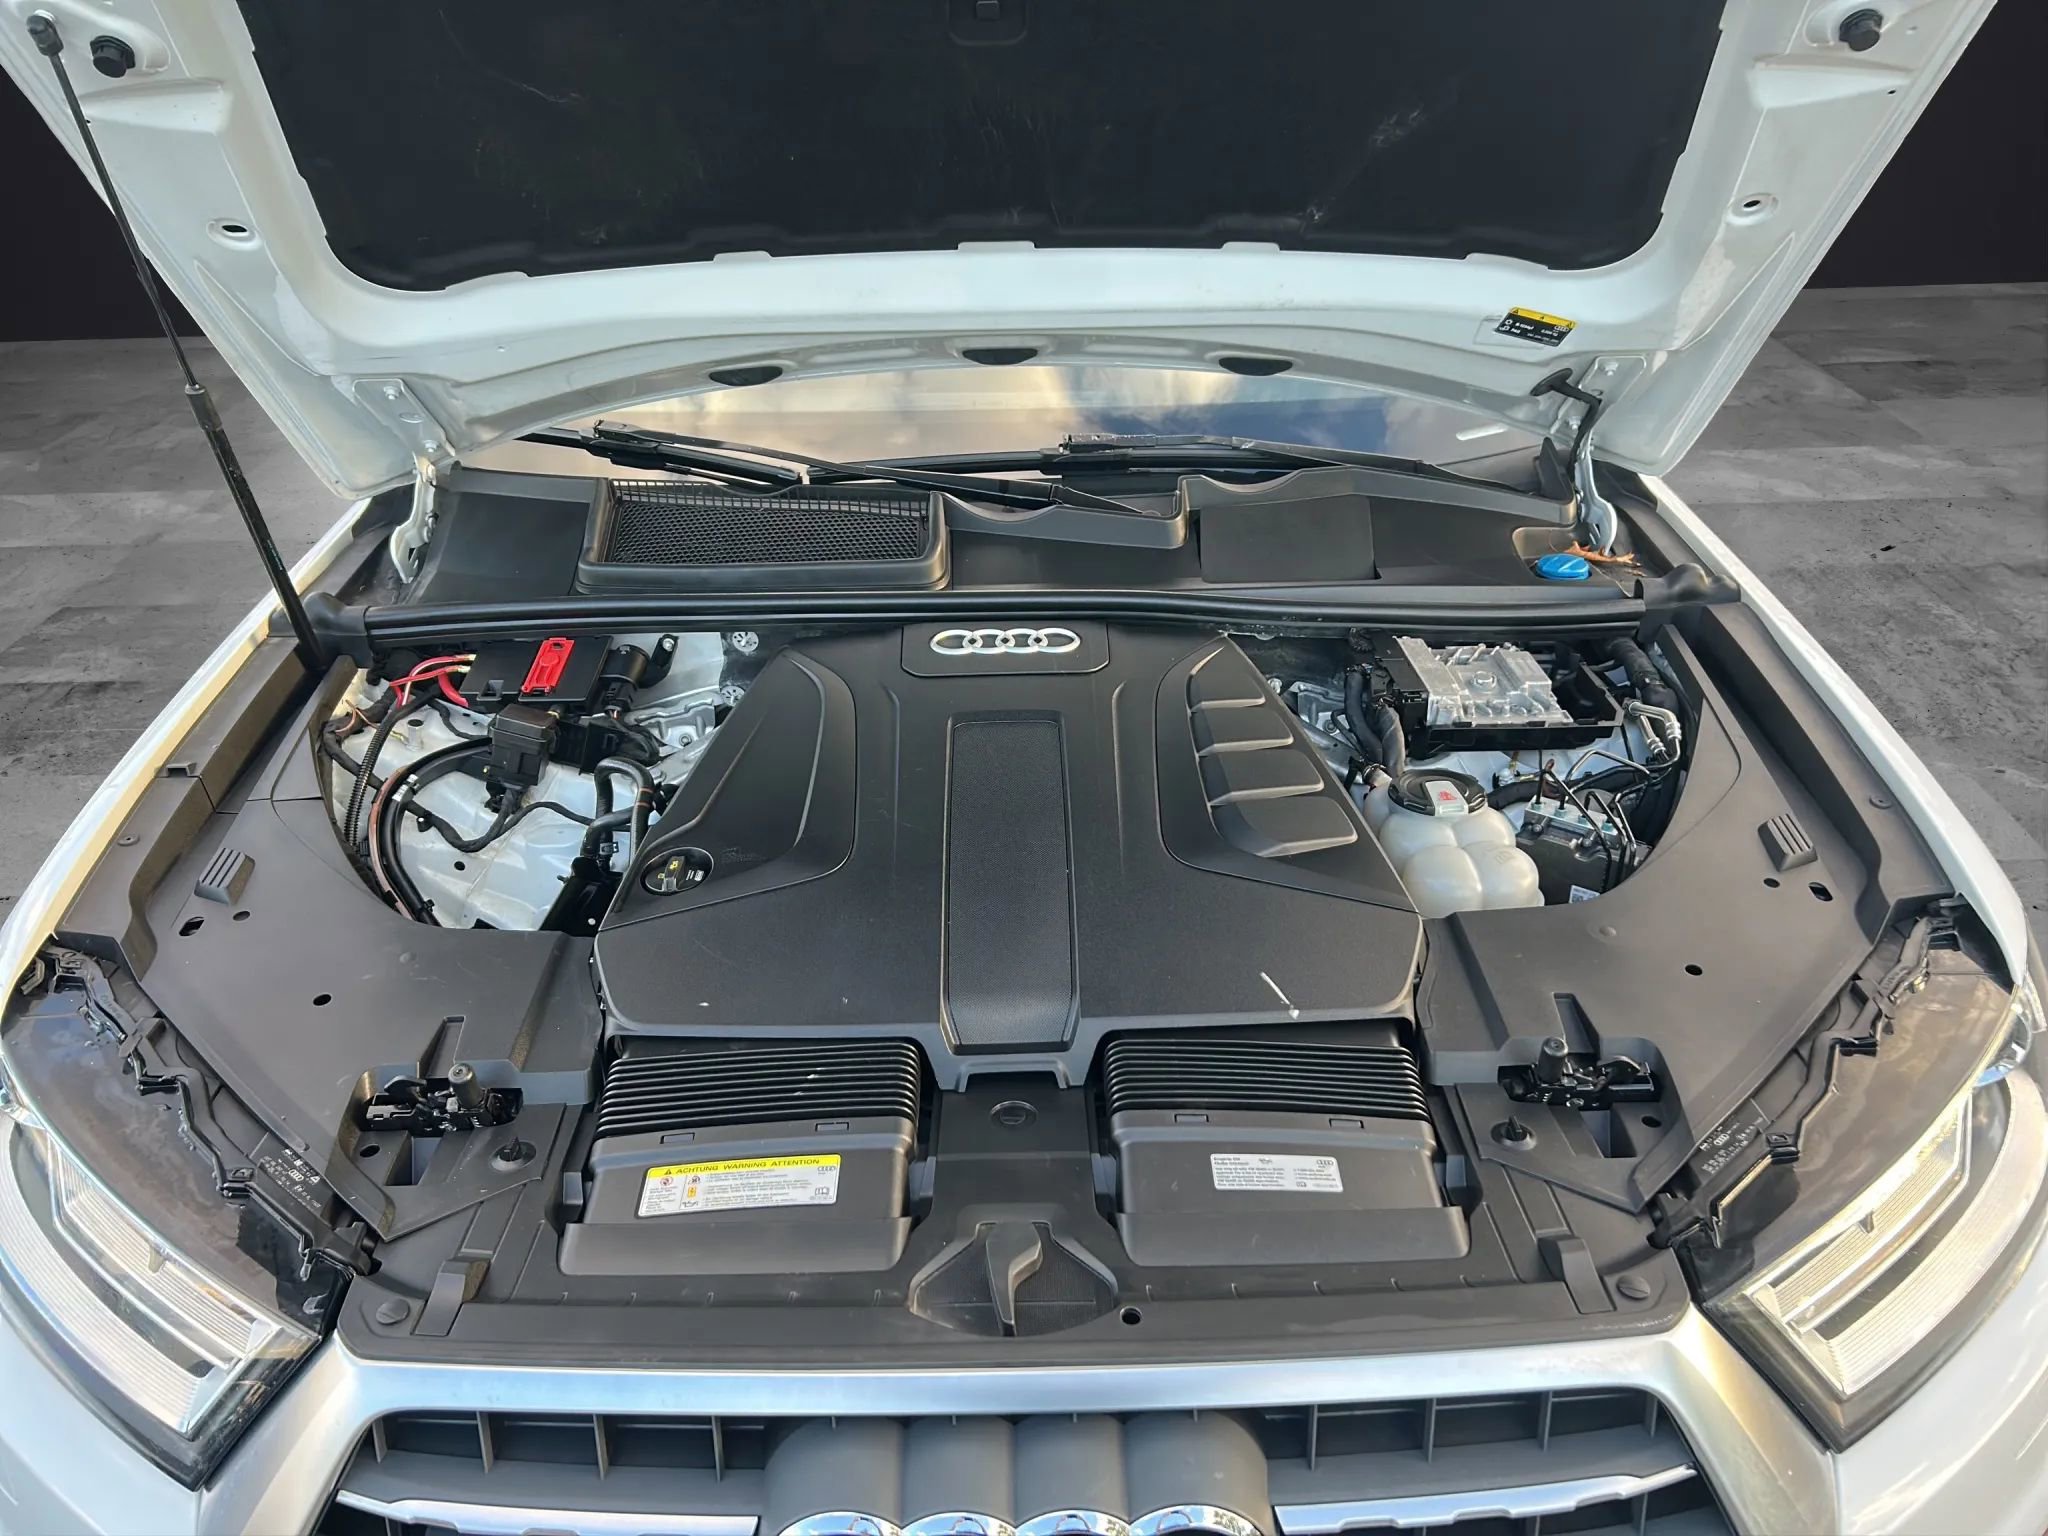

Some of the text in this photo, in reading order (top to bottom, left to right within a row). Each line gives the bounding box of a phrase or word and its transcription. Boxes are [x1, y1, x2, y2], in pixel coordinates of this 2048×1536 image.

[675, 1158, 820, 1174] ACHTUNG WARNING ATTENTION
